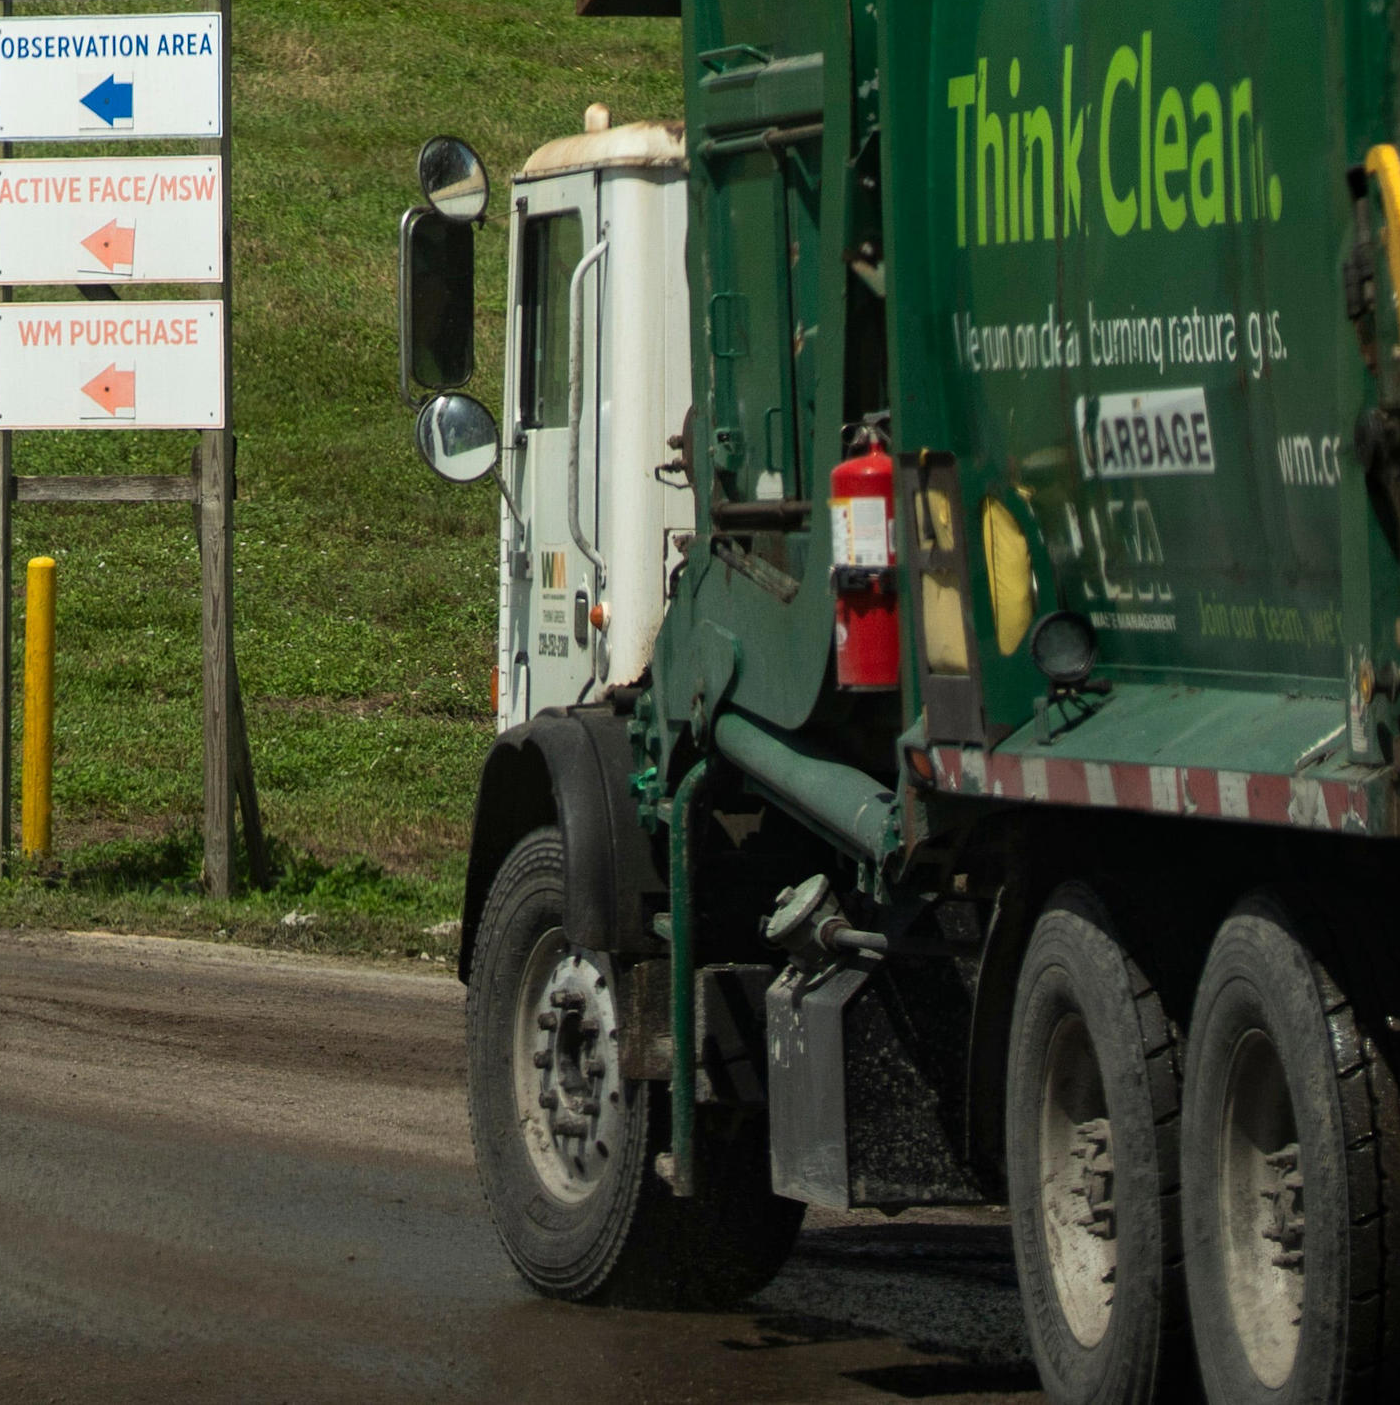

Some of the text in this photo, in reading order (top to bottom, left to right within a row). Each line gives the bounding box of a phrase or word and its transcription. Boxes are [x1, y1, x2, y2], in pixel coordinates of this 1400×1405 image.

[0, 32, 213, 60] OBSERVATION AREA
[947, 43, 1092, 248] Think
[88, 173, 217, 205] FACE/MSW
[17, 318, 199, 347] WM PURCHASE
[982, 317, 1011, 371] run
[1168, 305, 1238, 365] natura
[1083, 411, 1212, 471] ARBAGE
[541, 551, 567, 589] WM
